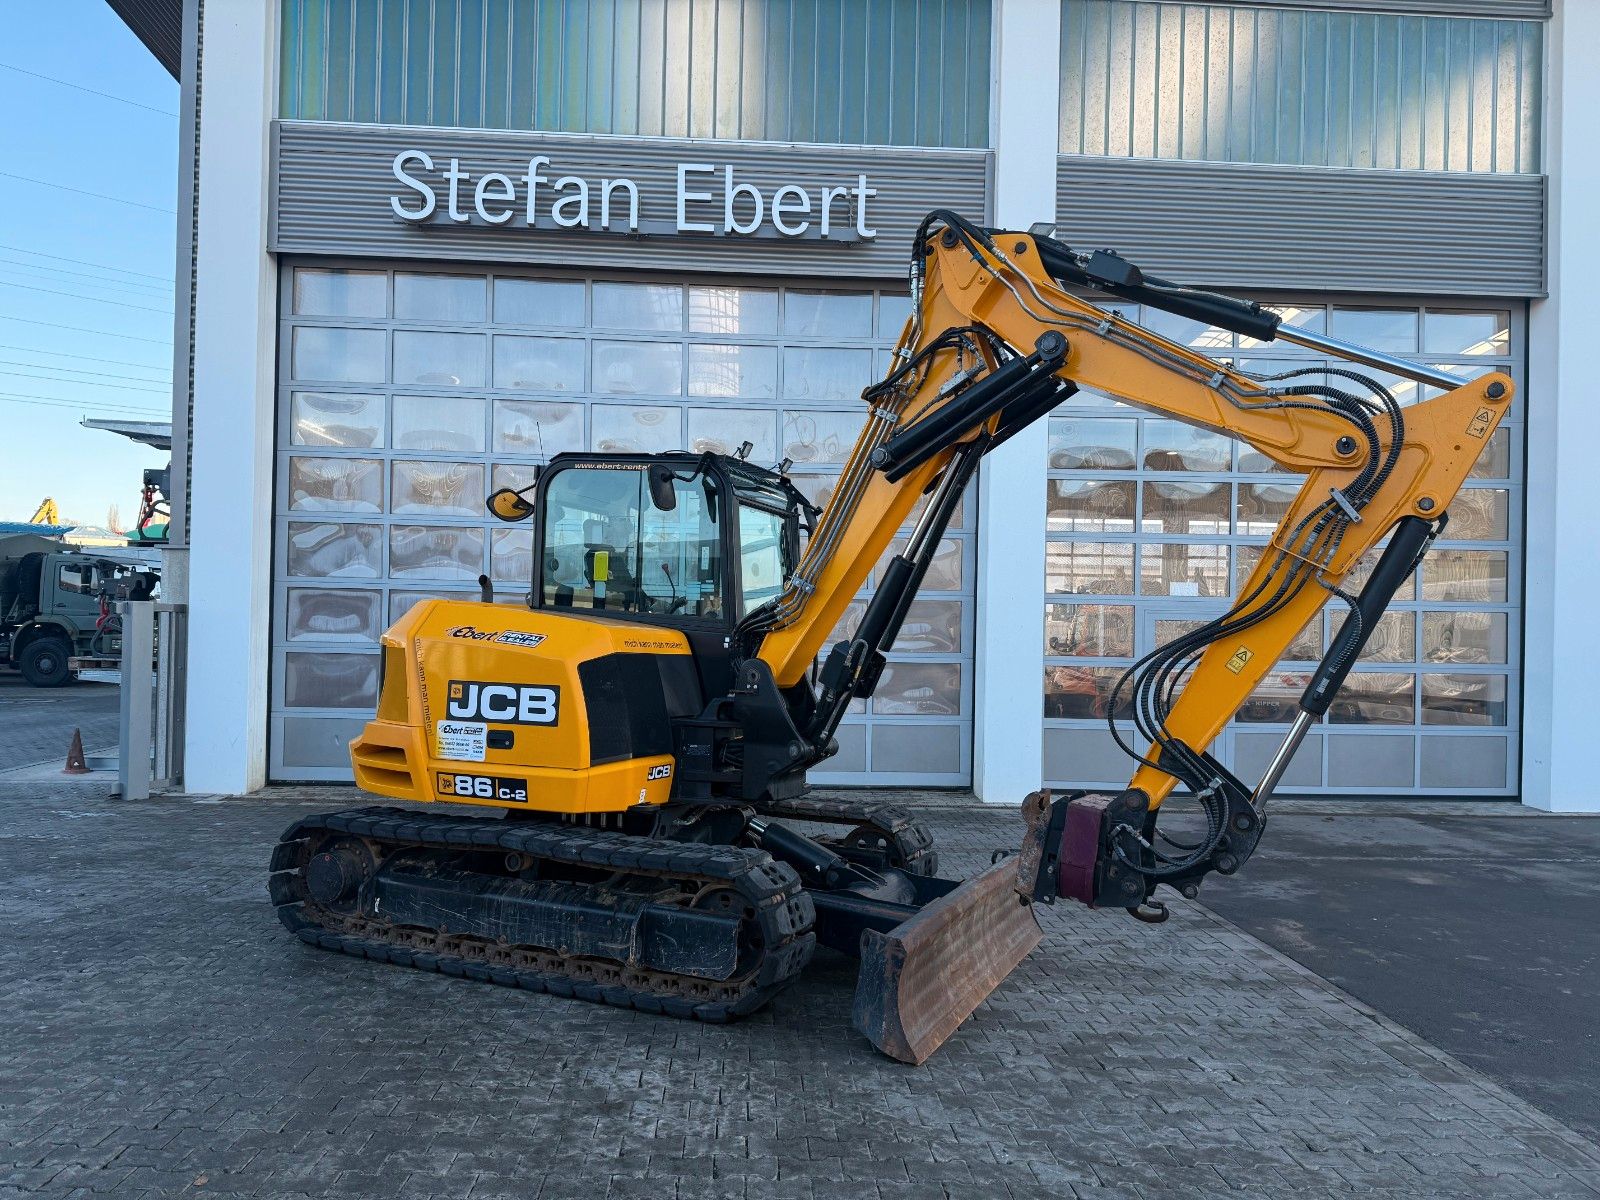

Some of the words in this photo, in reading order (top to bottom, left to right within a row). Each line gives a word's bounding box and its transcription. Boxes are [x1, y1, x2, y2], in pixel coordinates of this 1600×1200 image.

[390, 149, 639, 230] Stefan
[677, 163, 877, 238] Ebert
[452, 626, 498, 641] Ebert
[418, 661, 426, 682] kann
[420, 684, 429, 702] man
[449, 685, 556, 722] JCB
[648, 764, 671, 780] JCB
[454, 775, 493, 798] 86
[499, 788, 527, 801] C-2
